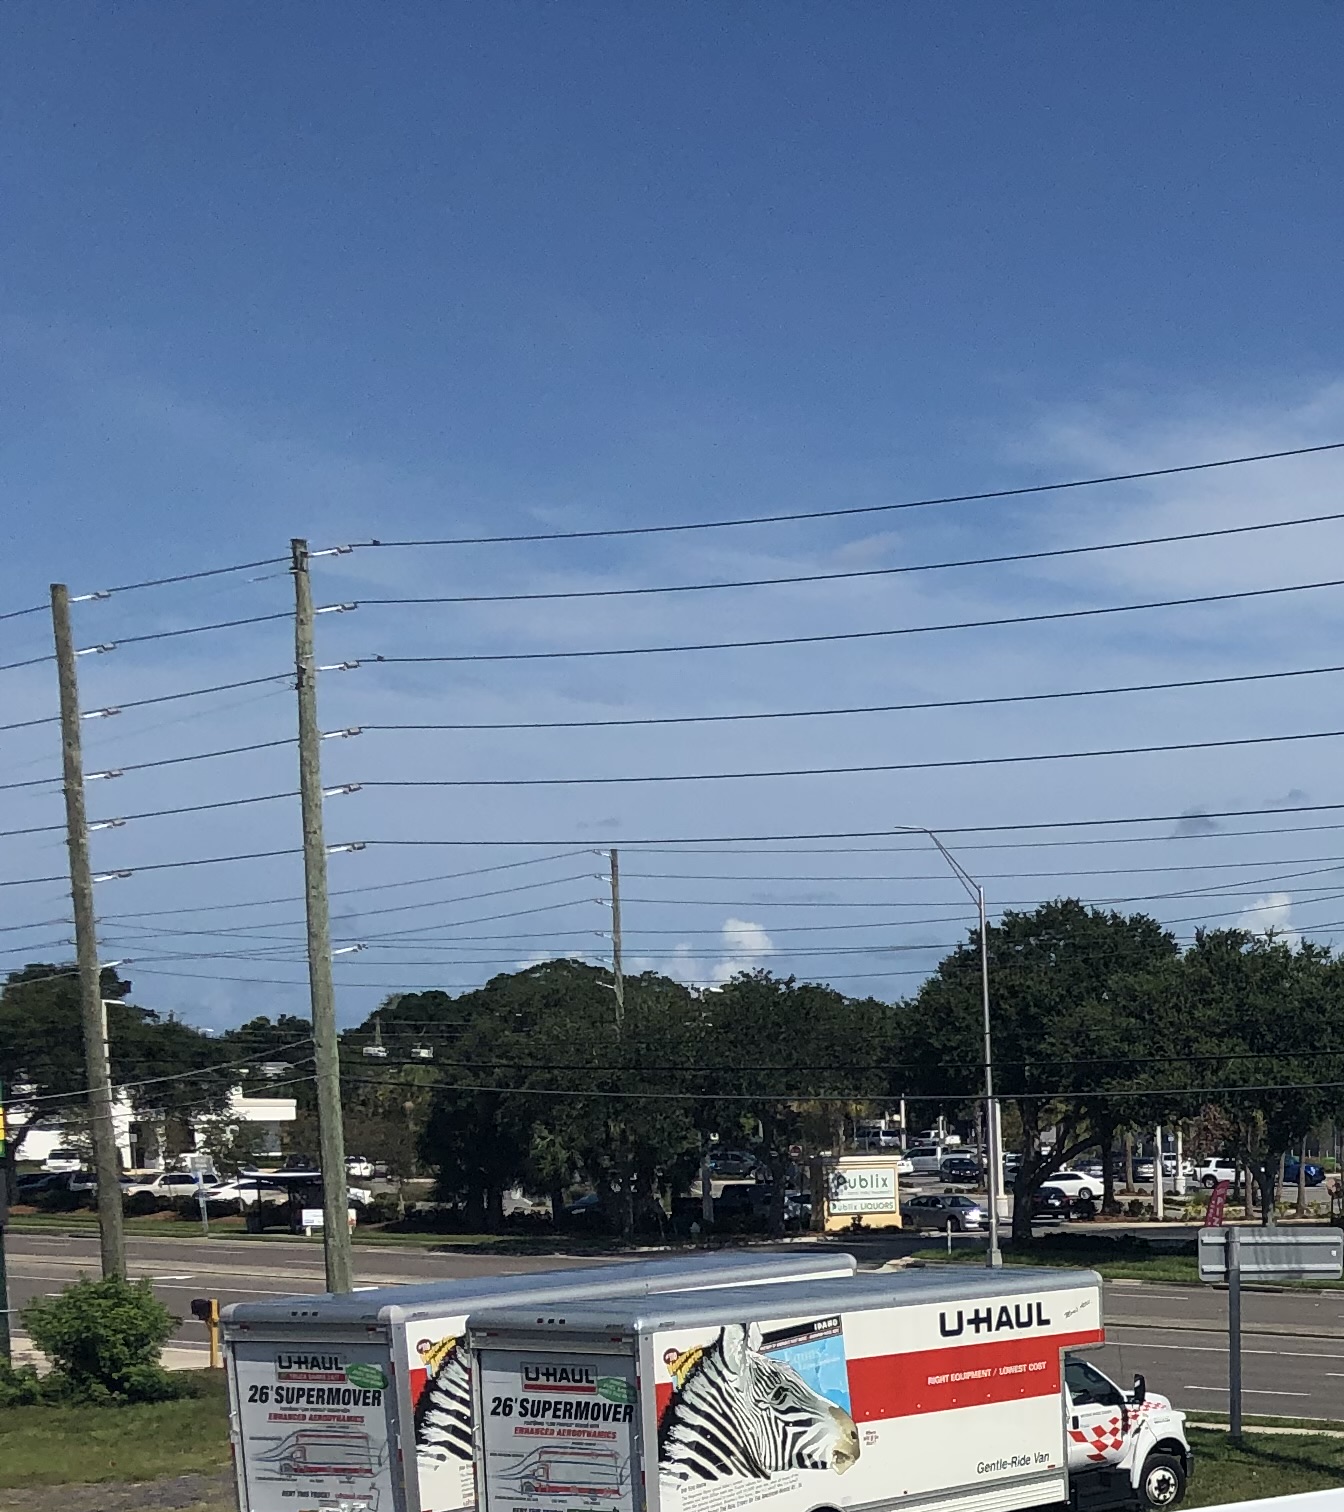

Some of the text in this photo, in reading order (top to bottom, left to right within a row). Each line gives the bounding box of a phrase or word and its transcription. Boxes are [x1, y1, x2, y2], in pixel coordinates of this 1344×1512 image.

[832, 1172, 889, 1190] Publix
[860, 1202, 893, 1211] LIQUORS
[814, 1319, 838, 1331] IDAHO
[939, 1302, 1051, 1338] U-HAUL
[278, 1355, 343, 1371] U-HAUL
[525, 1366, 595, 1384] U-HAUL
[928, 1373, 950, 1385] RIGHT
[951, 1369, 991, 1382] EQUIPMENT
[999, 1364, 1027, 1376] LOWEST
[1029, 1361, 1047, 1372] COST
[274, 1386, 382, 1407] SUPERMOVER
[519, 1400, 634, 1423] SUPERMOVER
[514, 1427, 617, 1439] ENHANCED AERODYNAMICS
[977, 1452, 1050, 1474] Gentle-Ride Van
